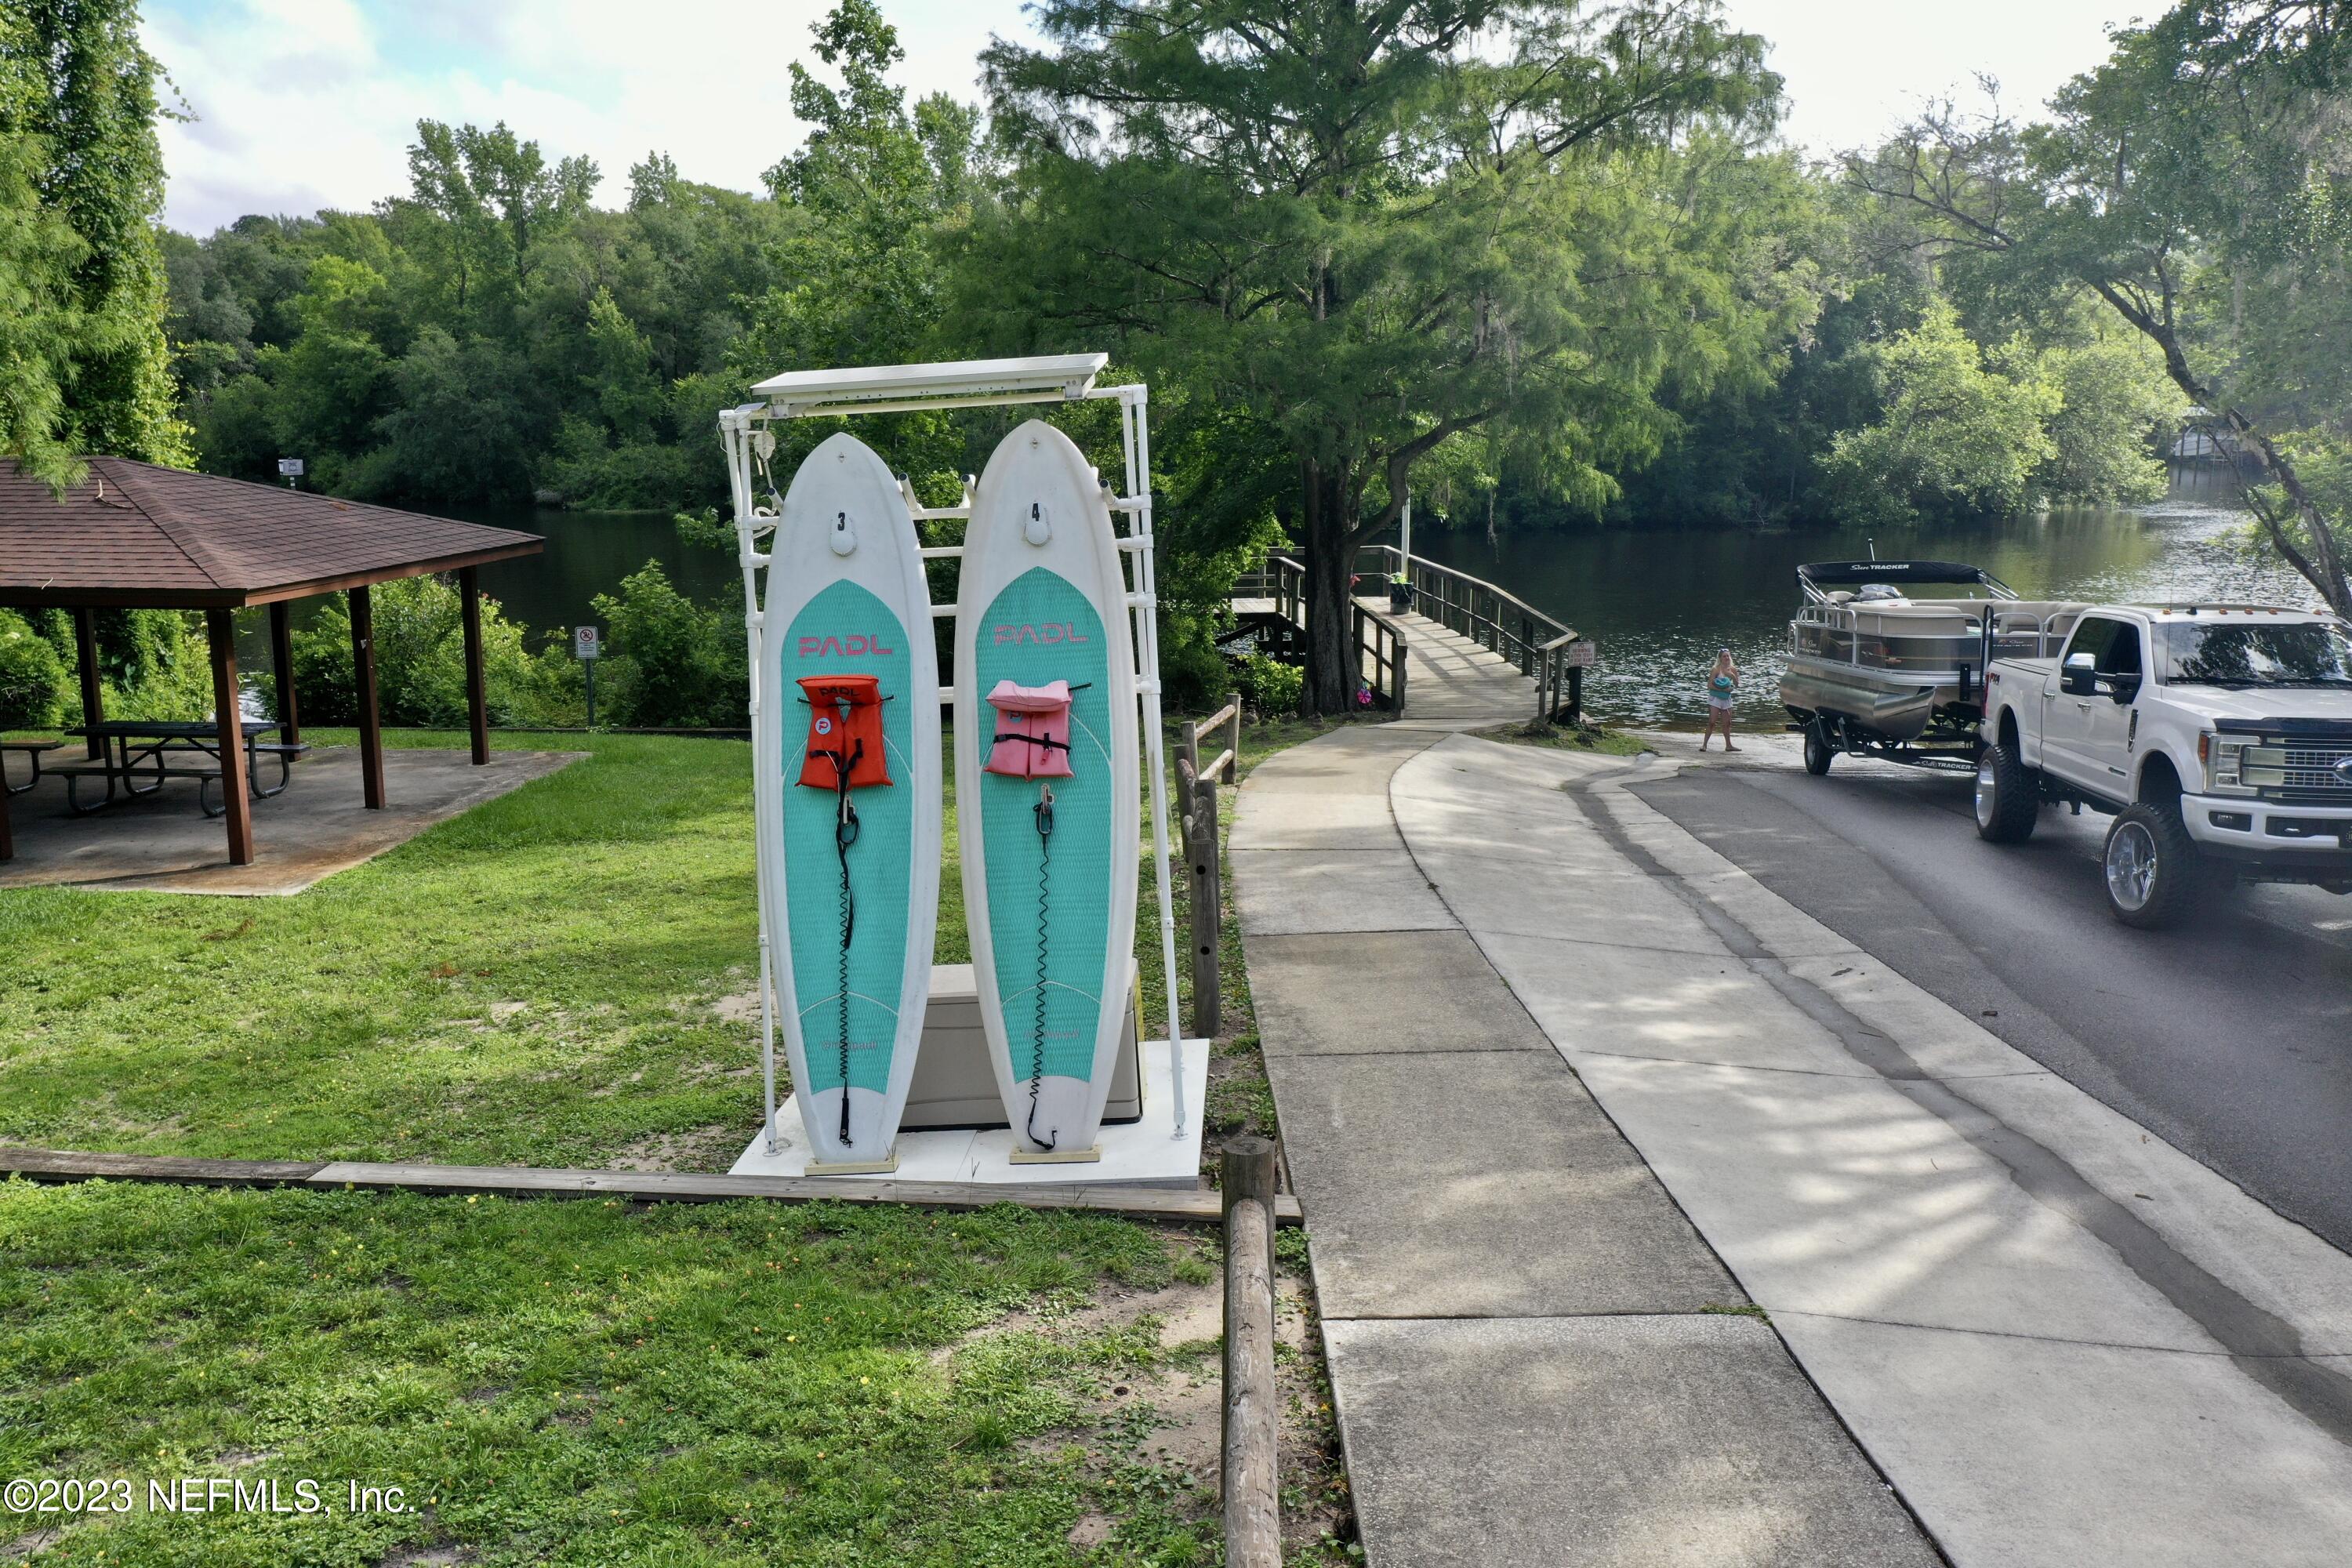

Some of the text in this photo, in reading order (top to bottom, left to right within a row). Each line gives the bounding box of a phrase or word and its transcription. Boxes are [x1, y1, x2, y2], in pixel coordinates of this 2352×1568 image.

[837, 512, 845, 531] 3
[1032, 503, 1040, 521] 4
[993, 622, 1088, 646] PADL
[798, 634, 892, 657] PADL
[818, 687, 861, 696] PADL
